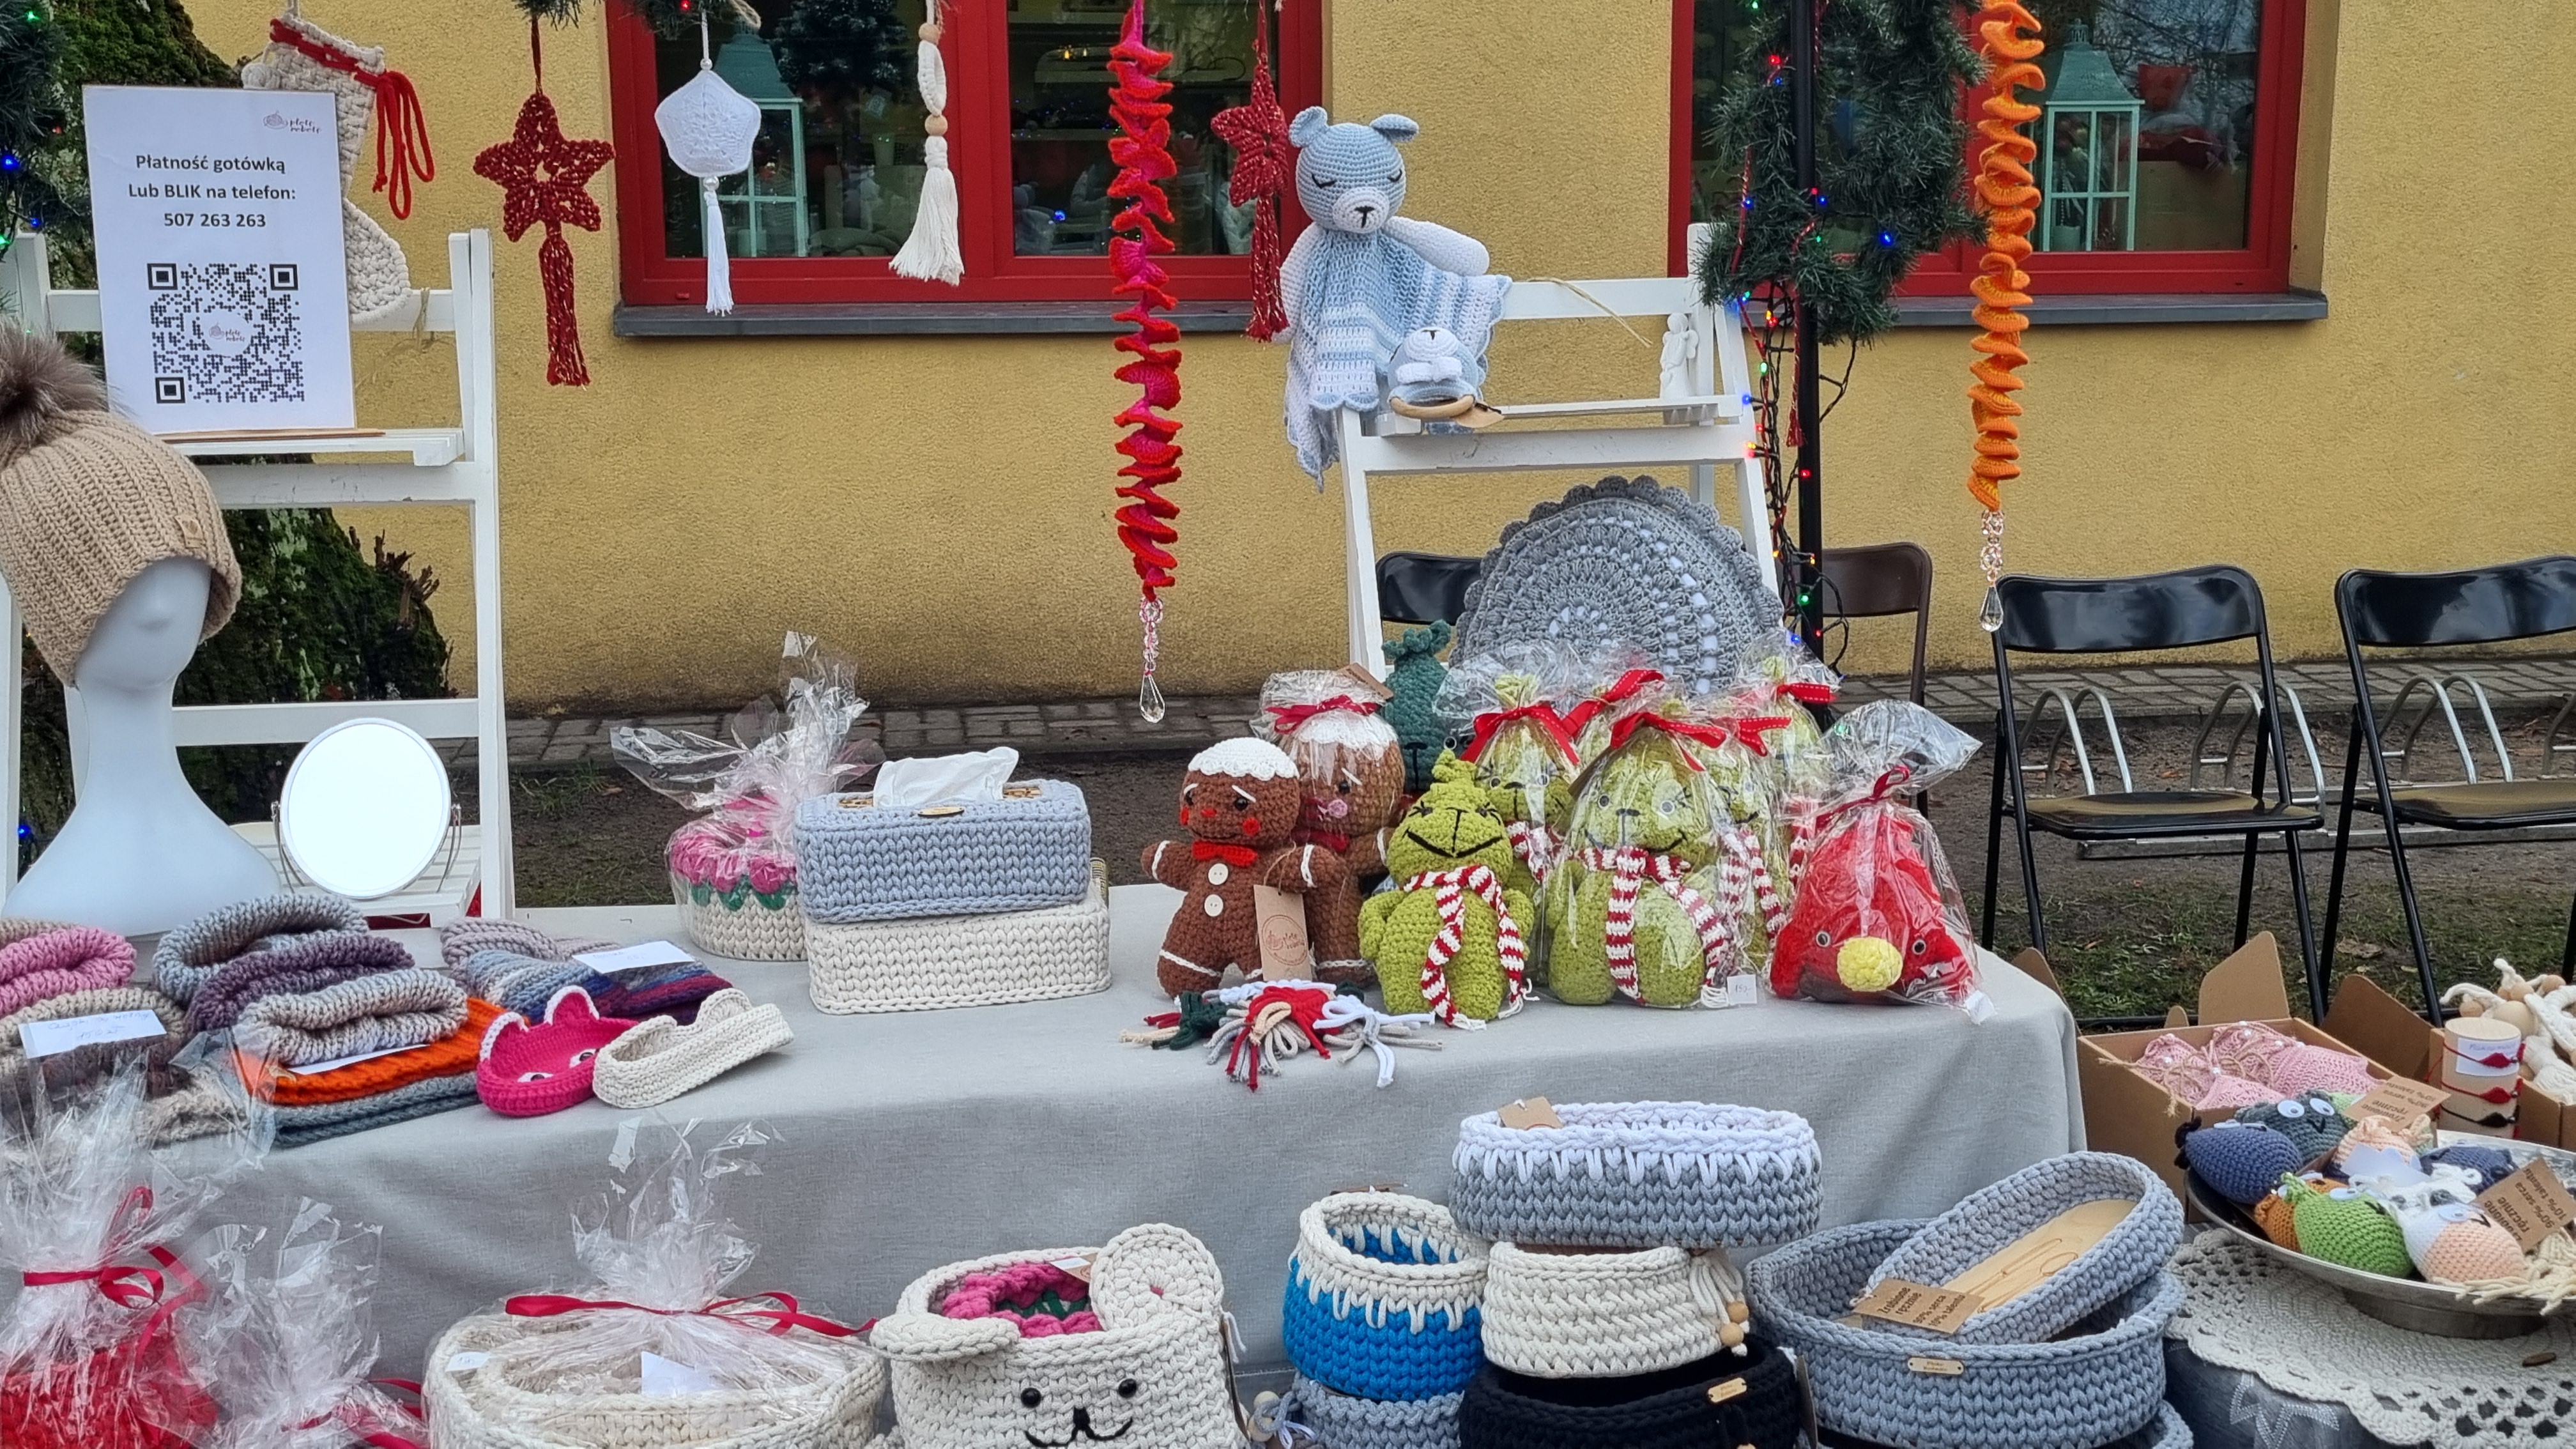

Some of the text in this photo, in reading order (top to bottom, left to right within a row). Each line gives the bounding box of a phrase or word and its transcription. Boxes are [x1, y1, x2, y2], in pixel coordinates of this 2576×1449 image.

[136, 155, 286, 174] Płatność gotówką
[128, 183, 296, 200] Lub BLIK na telefon:
[164, 213, 266, 227] 507 263 263
[2515, 1182, 2556, 1229] 90% serca
[2524, 1168, 2567, 1220] 10% talentu
[2497, 1197, 2531, 1233] ręcznie
